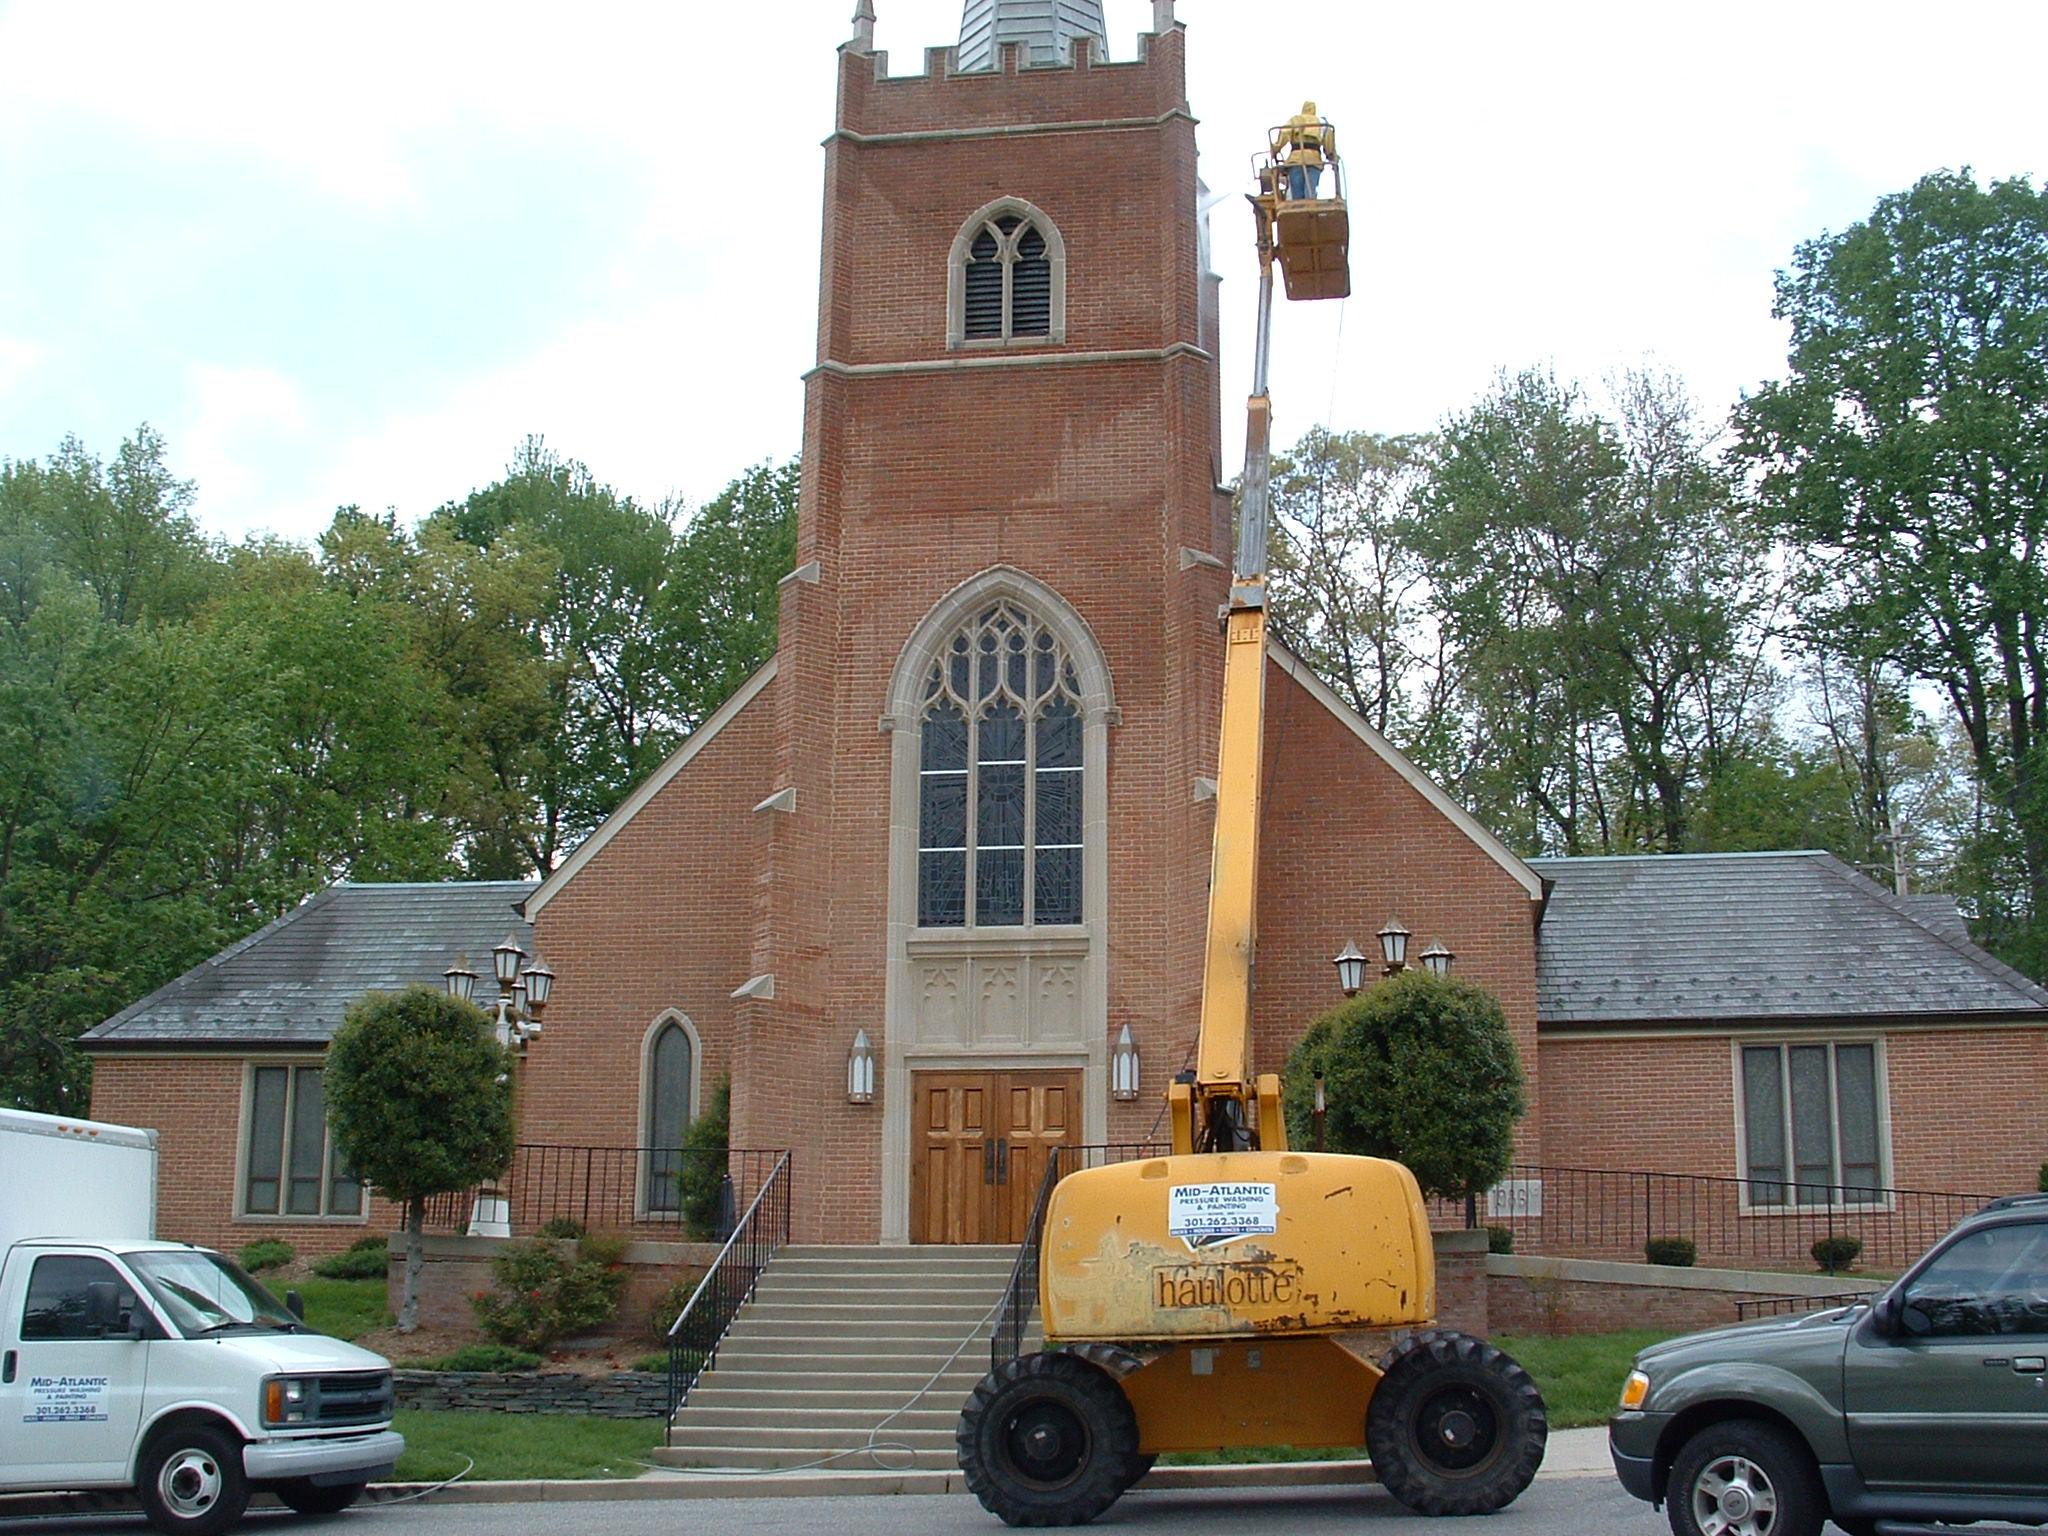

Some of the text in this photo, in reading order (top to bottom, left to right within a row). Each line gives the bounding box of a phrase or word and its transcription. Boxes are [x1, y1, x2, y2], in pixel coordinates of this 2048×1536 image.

[1174, 1186, 1270, 1198] MID-ATLANTIC
[1179, 1197, 1219, 1205] PRESSURE
[1184, 1216, 1260, 1227] 301.262.3368
[1159, 1266, 1293, 1308] haulotte
[30, 1376, 108, 1387] MID-ATLANTIC
[36, 1406, 96, 1414] 301.262.3368
